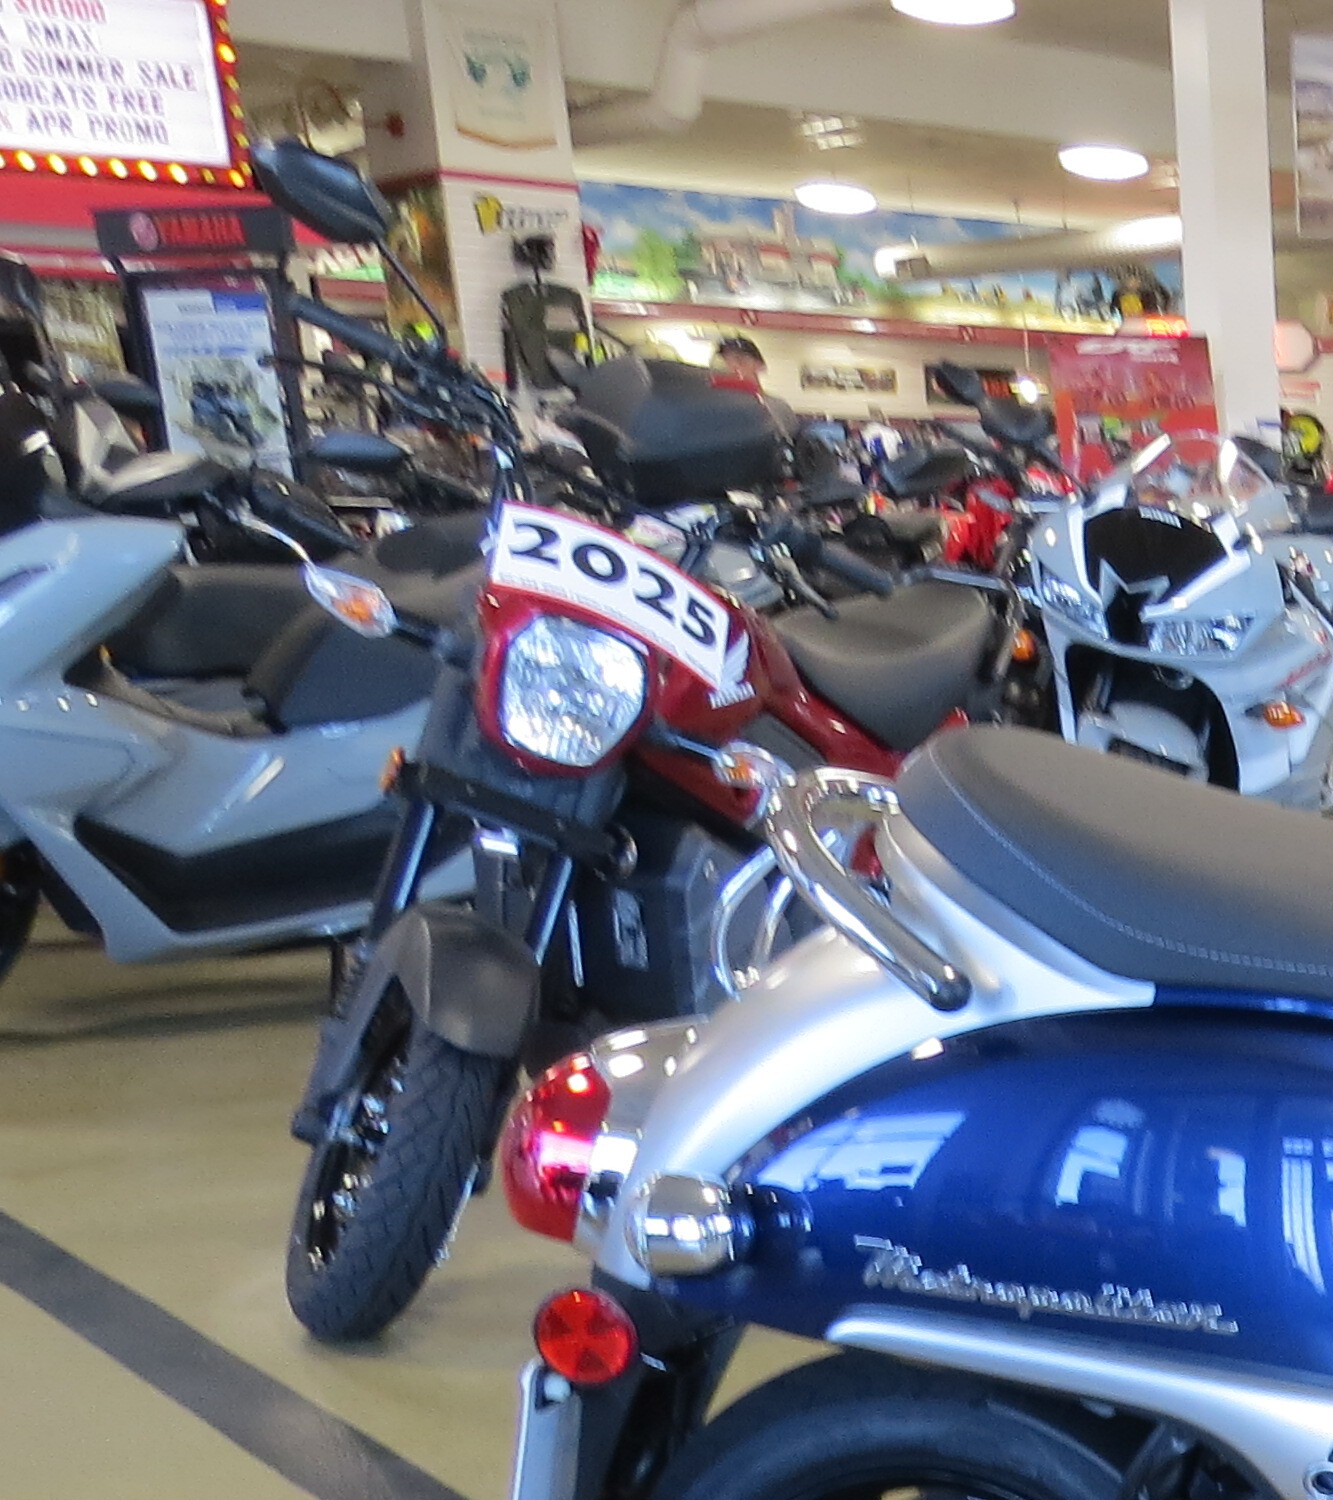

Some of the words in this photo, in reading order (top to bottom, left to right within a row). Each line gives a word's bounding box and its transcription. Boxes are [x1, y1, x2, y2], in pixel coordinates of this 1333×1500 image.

[22, 48, 125, 86] SUMMER
[138, 60, 197, 92] SALE
[86, 111, 169, 145] PROMO
[507, 517, 718, 647] 2025
